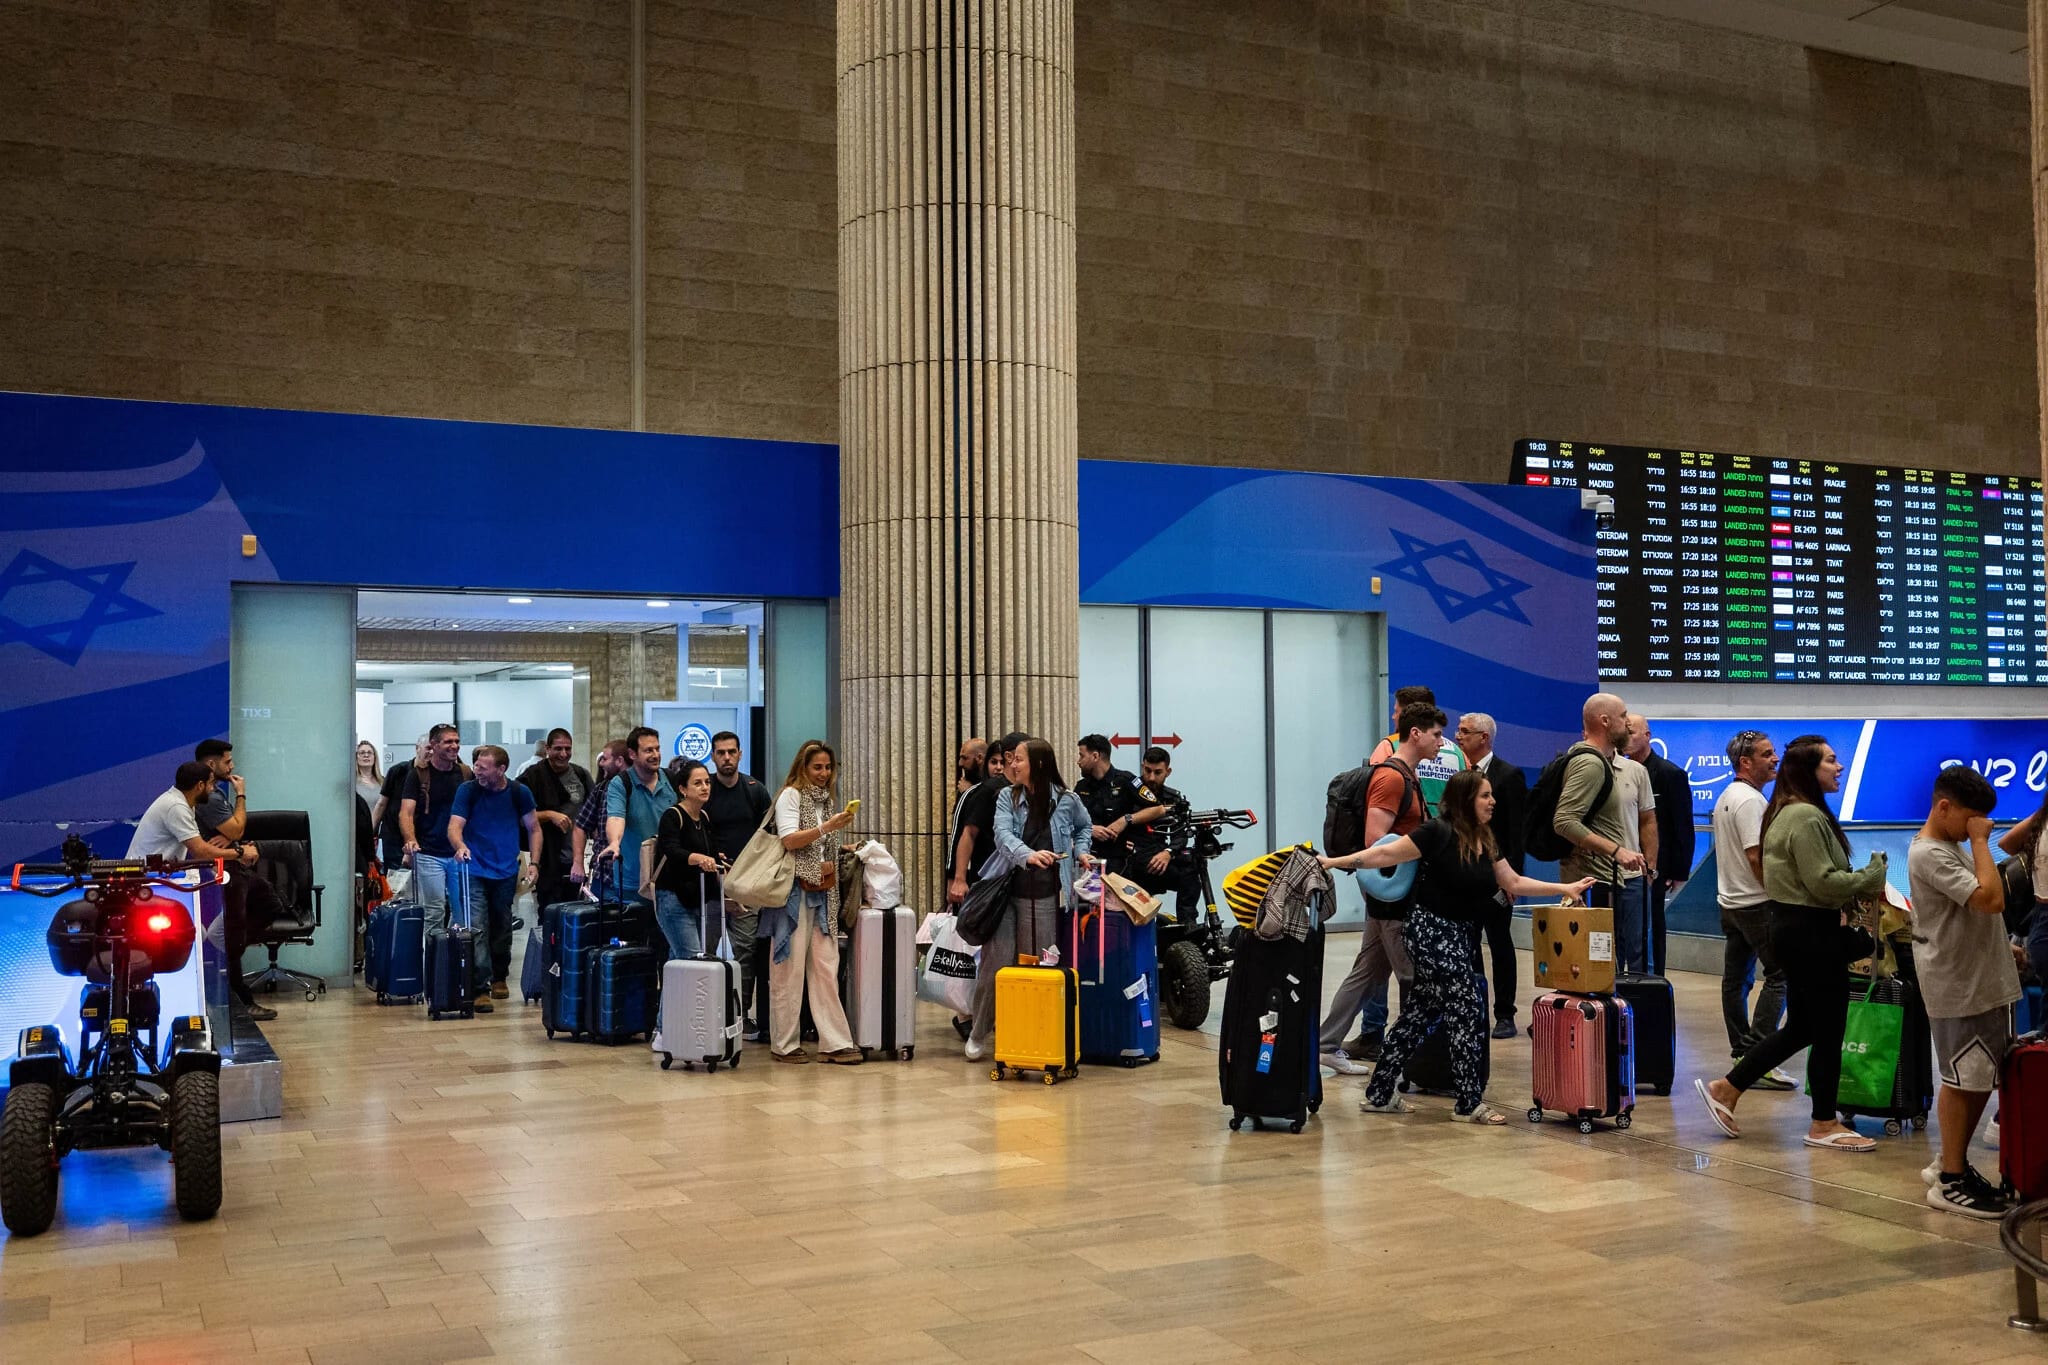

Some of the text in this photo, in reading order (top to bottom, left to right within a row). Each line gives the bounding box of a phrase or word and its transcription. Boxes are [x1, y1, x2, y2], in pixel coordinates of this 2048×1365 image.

[1529, 443, 1546, 451] 19:03
[1562, 461, 1574, 469] 396
[1588, 462, 1613, 472] MADRID
[1680, 469, 1715, 479] 16:55 18:10
[1724, 472, 1746, 480] LANDED
[1589, 480, 1614, 488] MADRID
[1824, 480, 1846, 488] PRAGUE
[1681, 486, 1716, 495] 16:55 18:10
[1724, 489, 1746, 497] LANDED
[1681, 502, 1716, 512] 16:55 18:10
[1724, 505, 1746, 513] LANDED
[1682, 519, 1716, 528] 16:55 18:10
[1725, 522, 1747, 530] LANDED
[1682, 536, 1717, 545] 17:20 18:24
[1725, 538, 1747, 546] LANDED
[1826, 544, 1850, 552] LARNACA
[1682, 552, 1717, 562] 17:20 18:24
[1826, 559, 1843, 567] TIVAT
[1683, 569, 1717, 578] 17:20 18:24
[1702, 587, 1718, 595] 18:08
[1702, 603, 1718, 611] 18:36
[1698, 756, 1720, 766] בבית
[1419, 770, 1451, 780] INSPECTO
[1694, 790, 1712, 800] גינדי
[690, 976, 710, 1052] Wrangler
